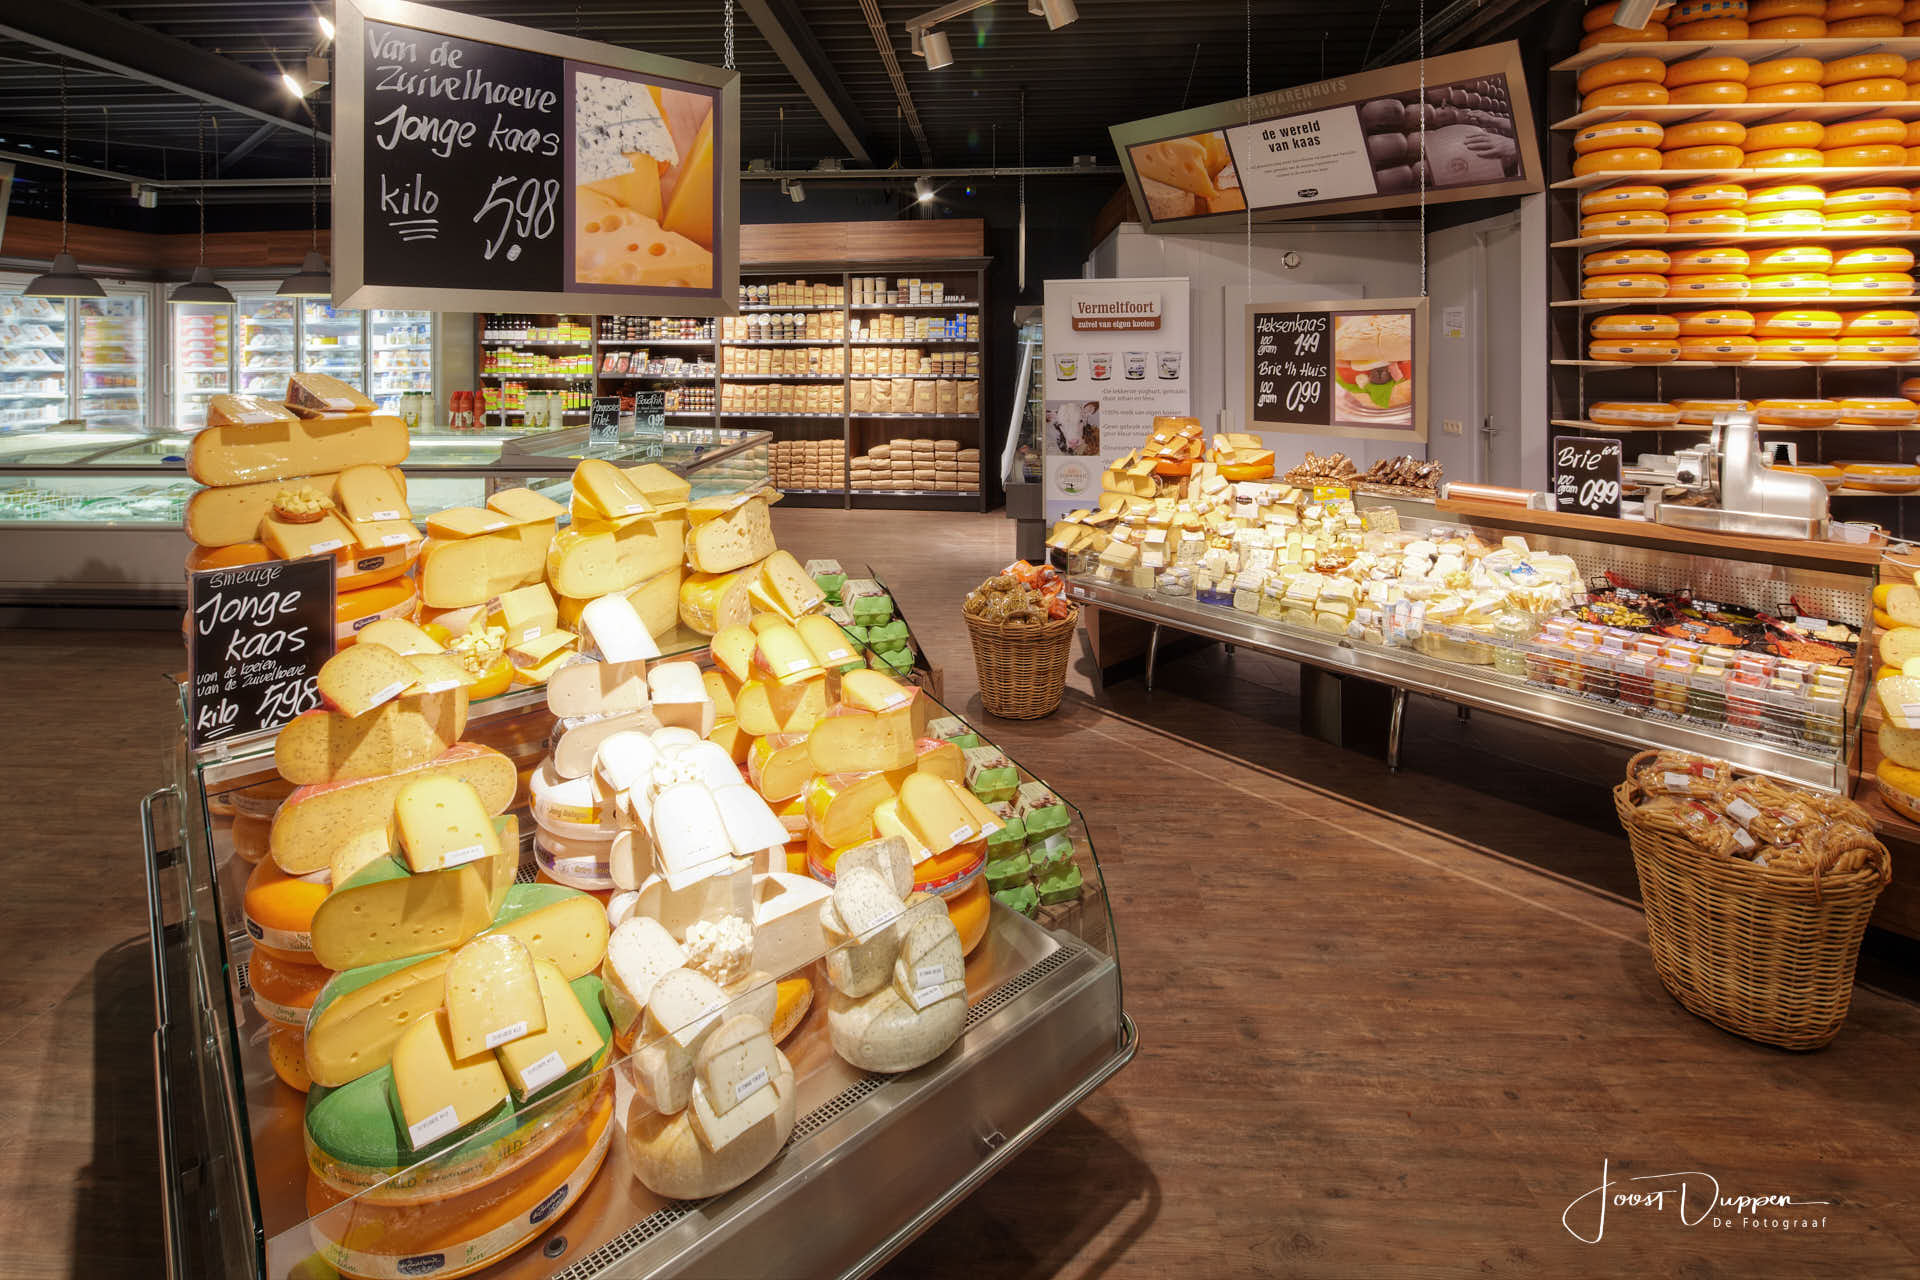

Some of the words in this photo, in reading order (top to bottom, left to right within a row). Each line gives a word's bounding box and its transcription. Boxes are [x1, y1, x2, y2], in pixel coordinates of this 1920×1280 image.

[368, 29, 416, 63] Van
[430, 41, 463, 69] de
[375, 65, 557, 114] Zuivelhoeve
[374, 105, 476, 158] Jonge
[488, 113, 559, 156] kaas
[1262, 129, 1276, 141] de
[1279, 120, 1321, 138] wereld
[1269, 140, 1289, 153] van
[1292, 135, 1321, 149] kaas
[381, 173, 439, 215] kilo
[1077, 301, 1154, 314] Vermeltfoort
[1078, 320, 1097, 328] zuivel
[1257, 314, 1327, 333] Heksenkaas
[1257, 344, 1278, 356] gram
[1259, 335, 1273, 345] 100
[1258, 361, 1282, 376] Brie
[1299, 362, 1327, 377] Huis
[1257, 393, 1278, 407] gram
[1286, 381, 1321, 412] 0.99
[1259, 381, 1274, 393] 100
[1558, 446, 1602, 471] Brie
[1557, 474, 1575, 485] 100
[1557, 485, 1578, 495] gram
[1579, 478, 1619, 511] 0.99
[196, 591, 301, 635] Jonge
[225, 627, 308, 661] kaas
[197, 671, 218, 685] van
[224, 666, 237, 679] de
[240, 660, 276, 676] koeien
[197, 684, 219, 697] van
[225, 679, 237, 691] de
[242, 664, 306, 688] Zuivelhoeve
[197, 698, 239, 730] kilo
